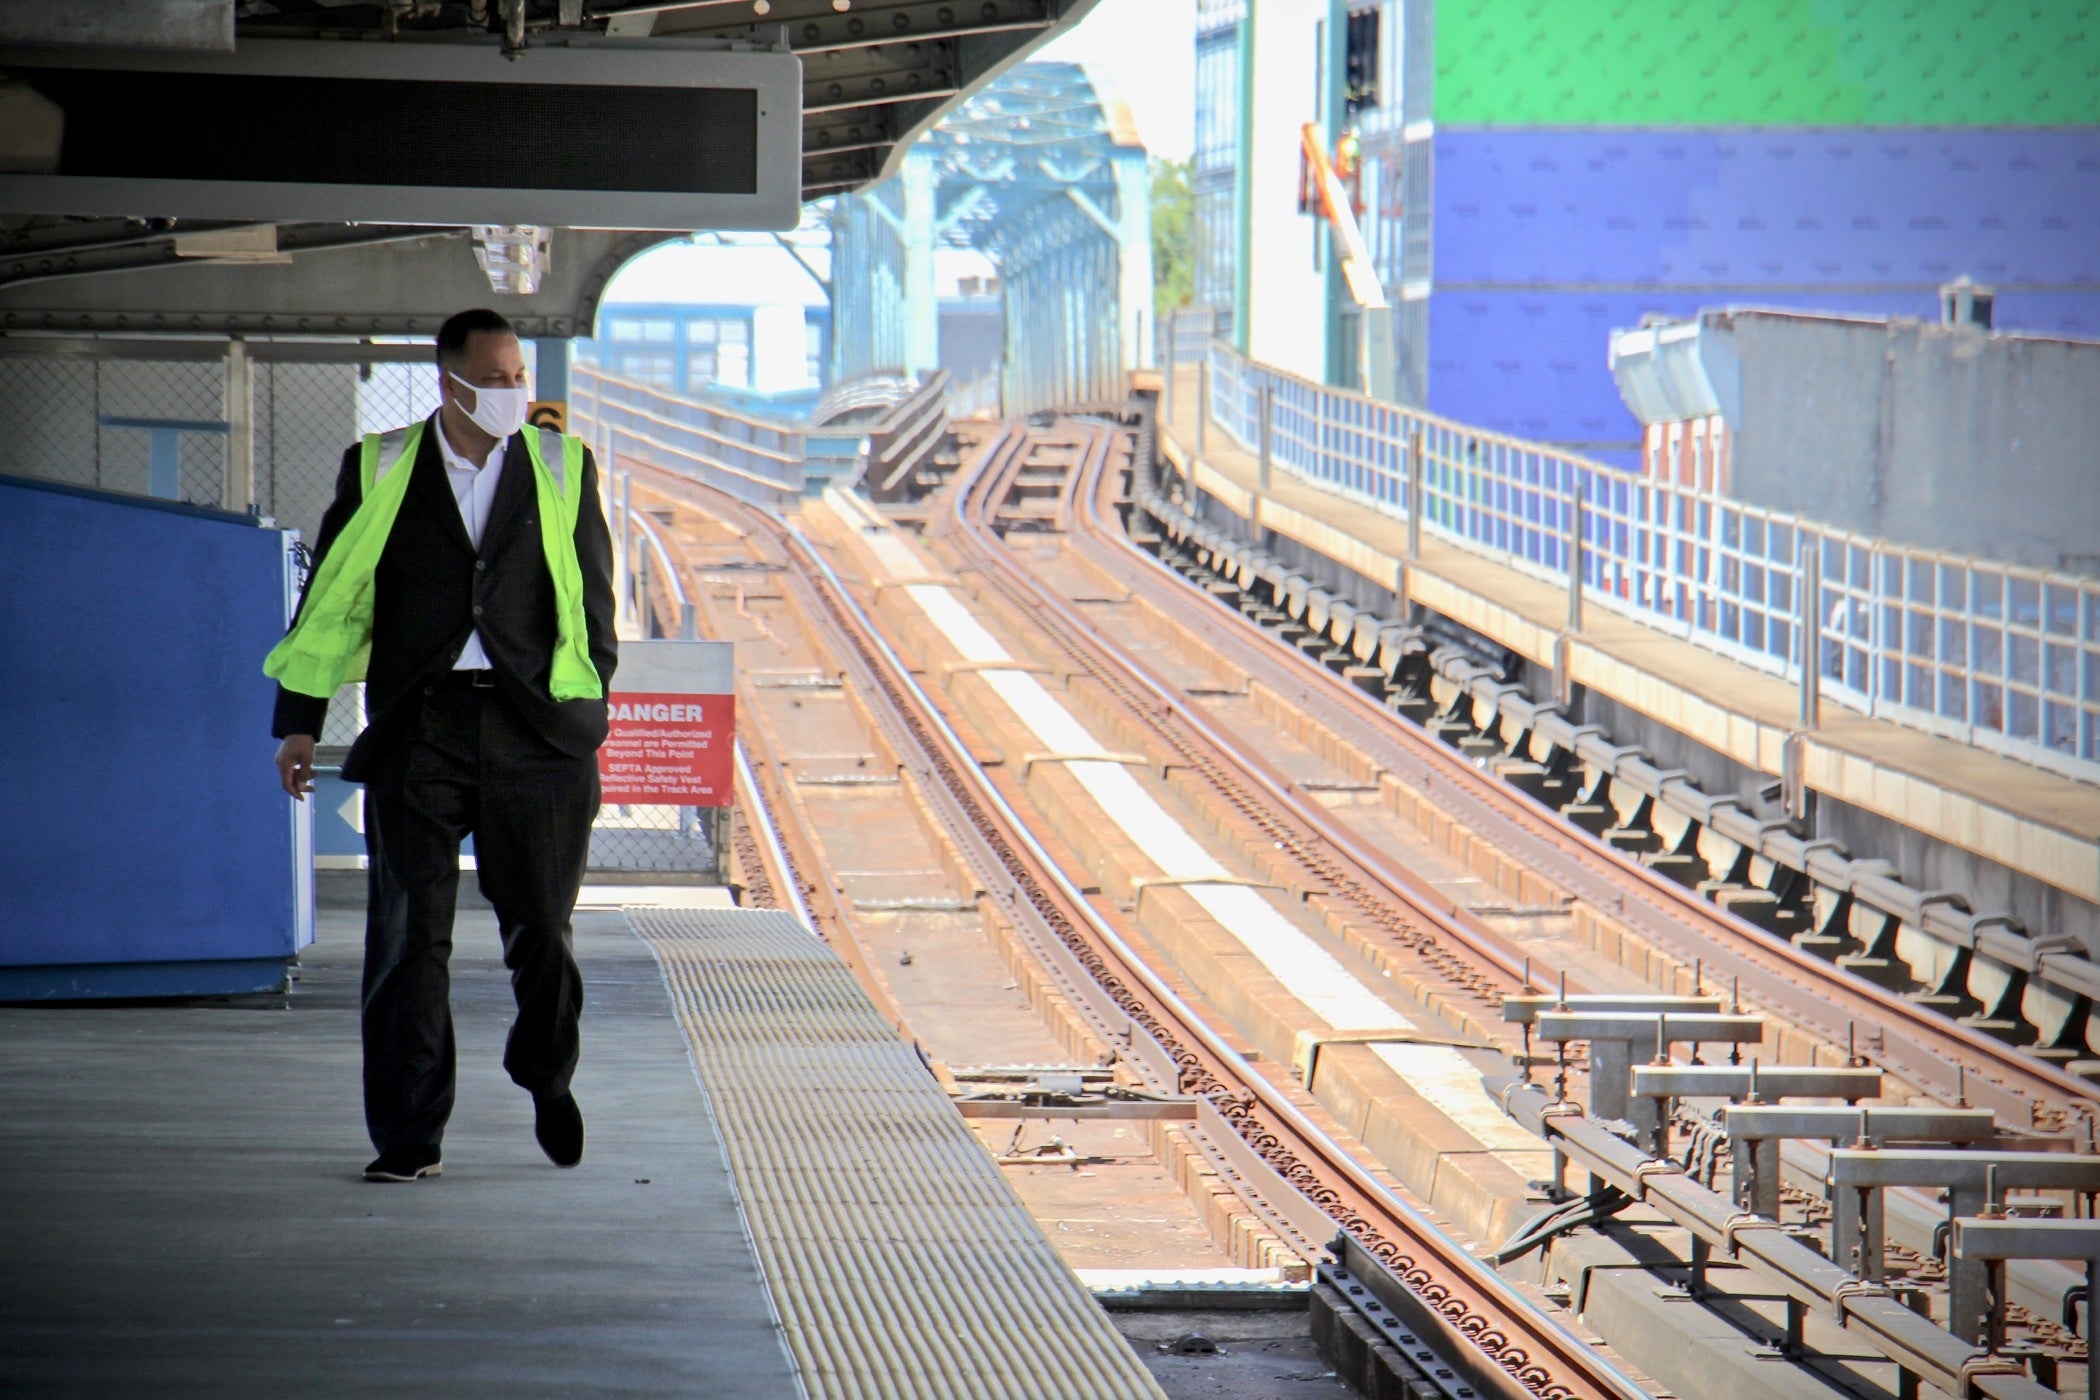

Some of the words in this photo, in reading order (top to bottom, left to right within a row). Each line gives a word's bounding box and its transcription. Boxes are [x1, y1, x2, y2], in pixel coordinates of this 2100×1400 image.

[601, 739, 642, 747] rsonnel
[662, 740, 708, 748] Permitted
[607, 750, 643, 759] Beyond
[646, 750, 666, 758] This
[669, 750, 694, 758] Point
[609, 764, 642, 772] SEPTA
[645, 764, 692, 775] Approved
[647, 775, 678, 785] Safety
[680, 775, 702, 784] Vest
[601, 785, 630, 794] quired
[643, 785, 658, 793] the
[662, 785, 688, 793] Track
[691, 786, 713, 794] Area
